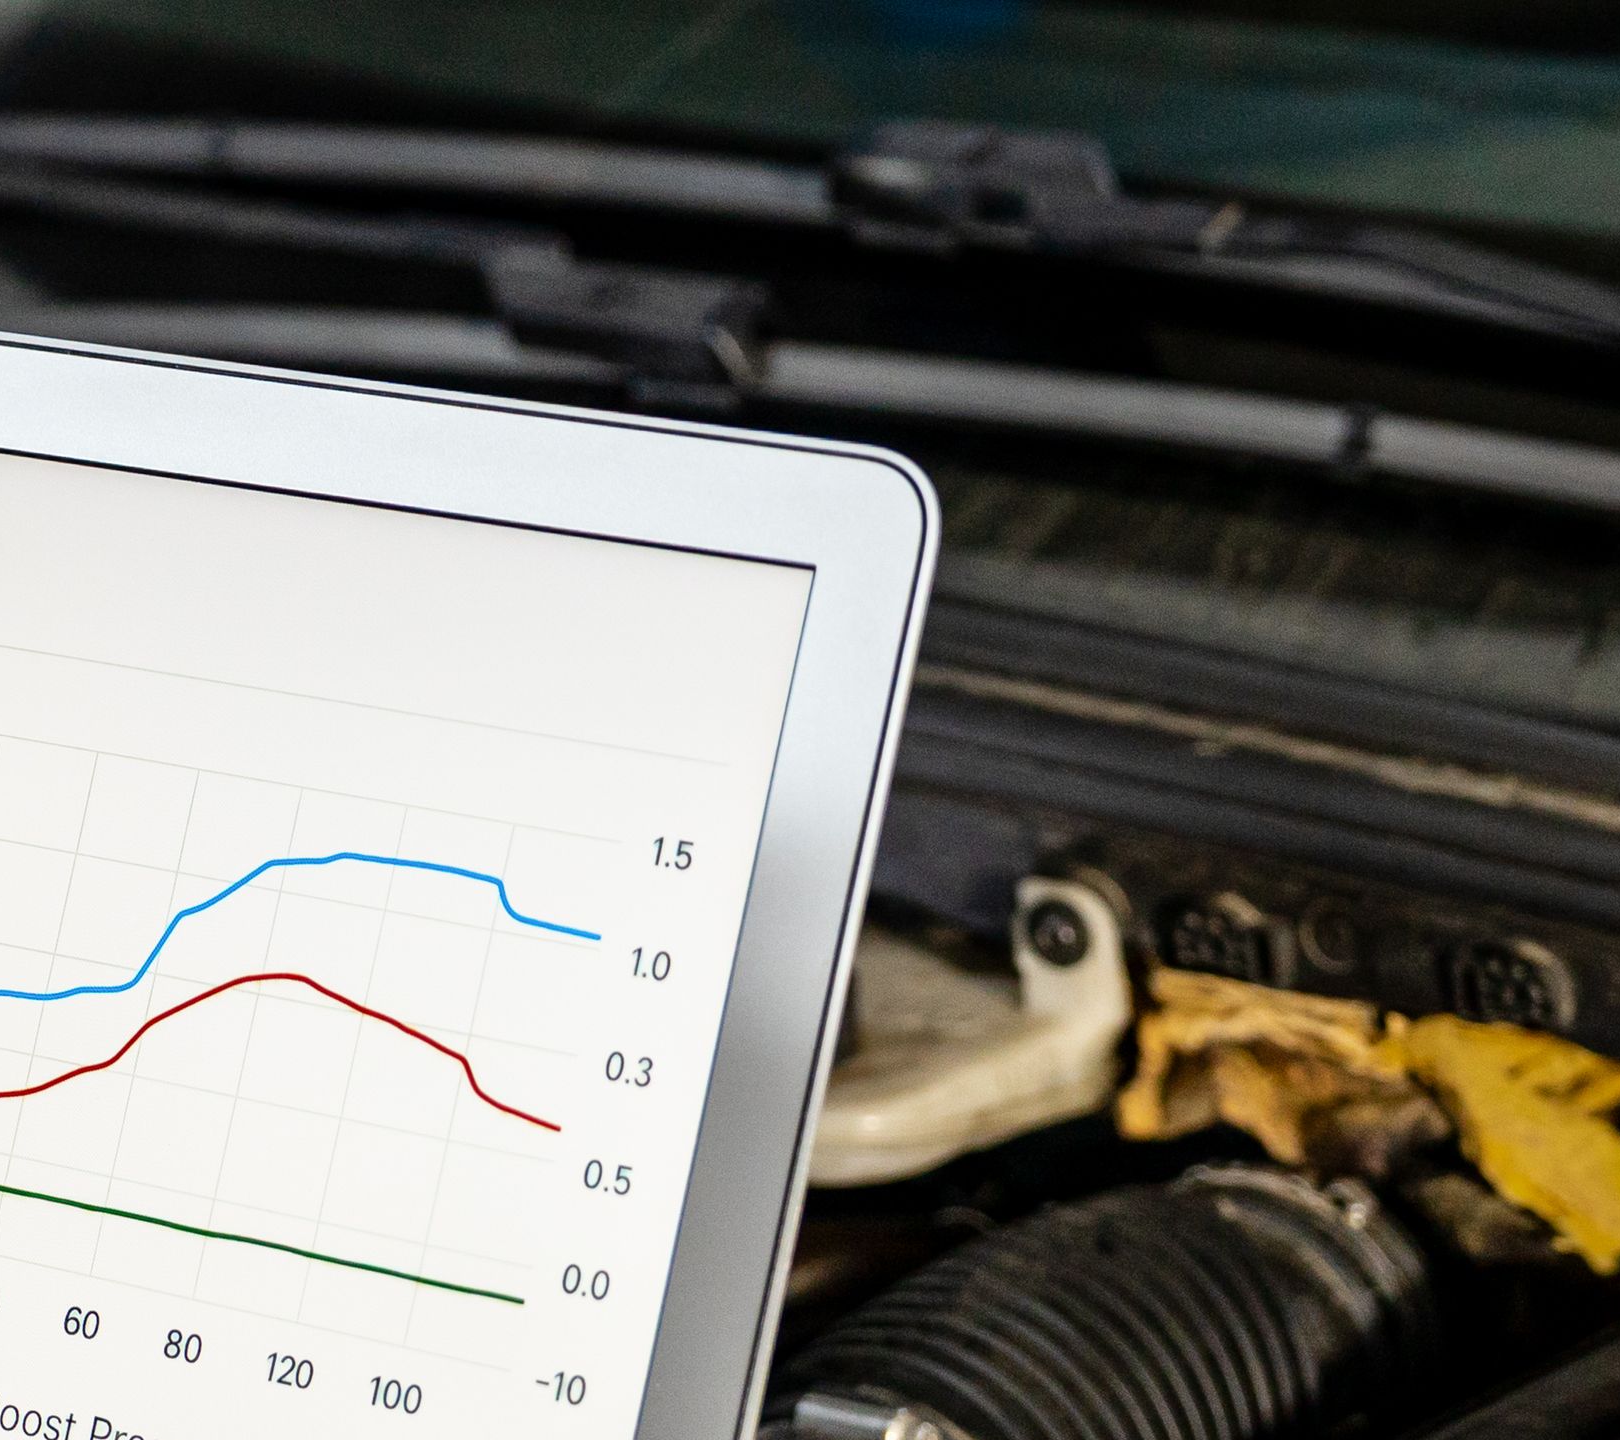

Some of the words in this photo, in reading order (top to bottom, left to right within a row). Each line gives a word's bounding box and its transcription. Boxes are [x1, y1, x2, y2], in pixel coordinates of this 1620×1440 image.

[652, 835, 695, 872] 1.5
[631, 945, 673, 983] 1.0
[604, 1050, 655, 1089] 0.3
[582, 1158, 634, 1197] 0.5
[560, 1262, 612, 1302] 0.0
[62, 1304, 102, 1341] 60
[162, 1327, 204, 1365] 80
[266, 1350, 316, 1391] 120
[369, 1374, 424, 1416] 100
